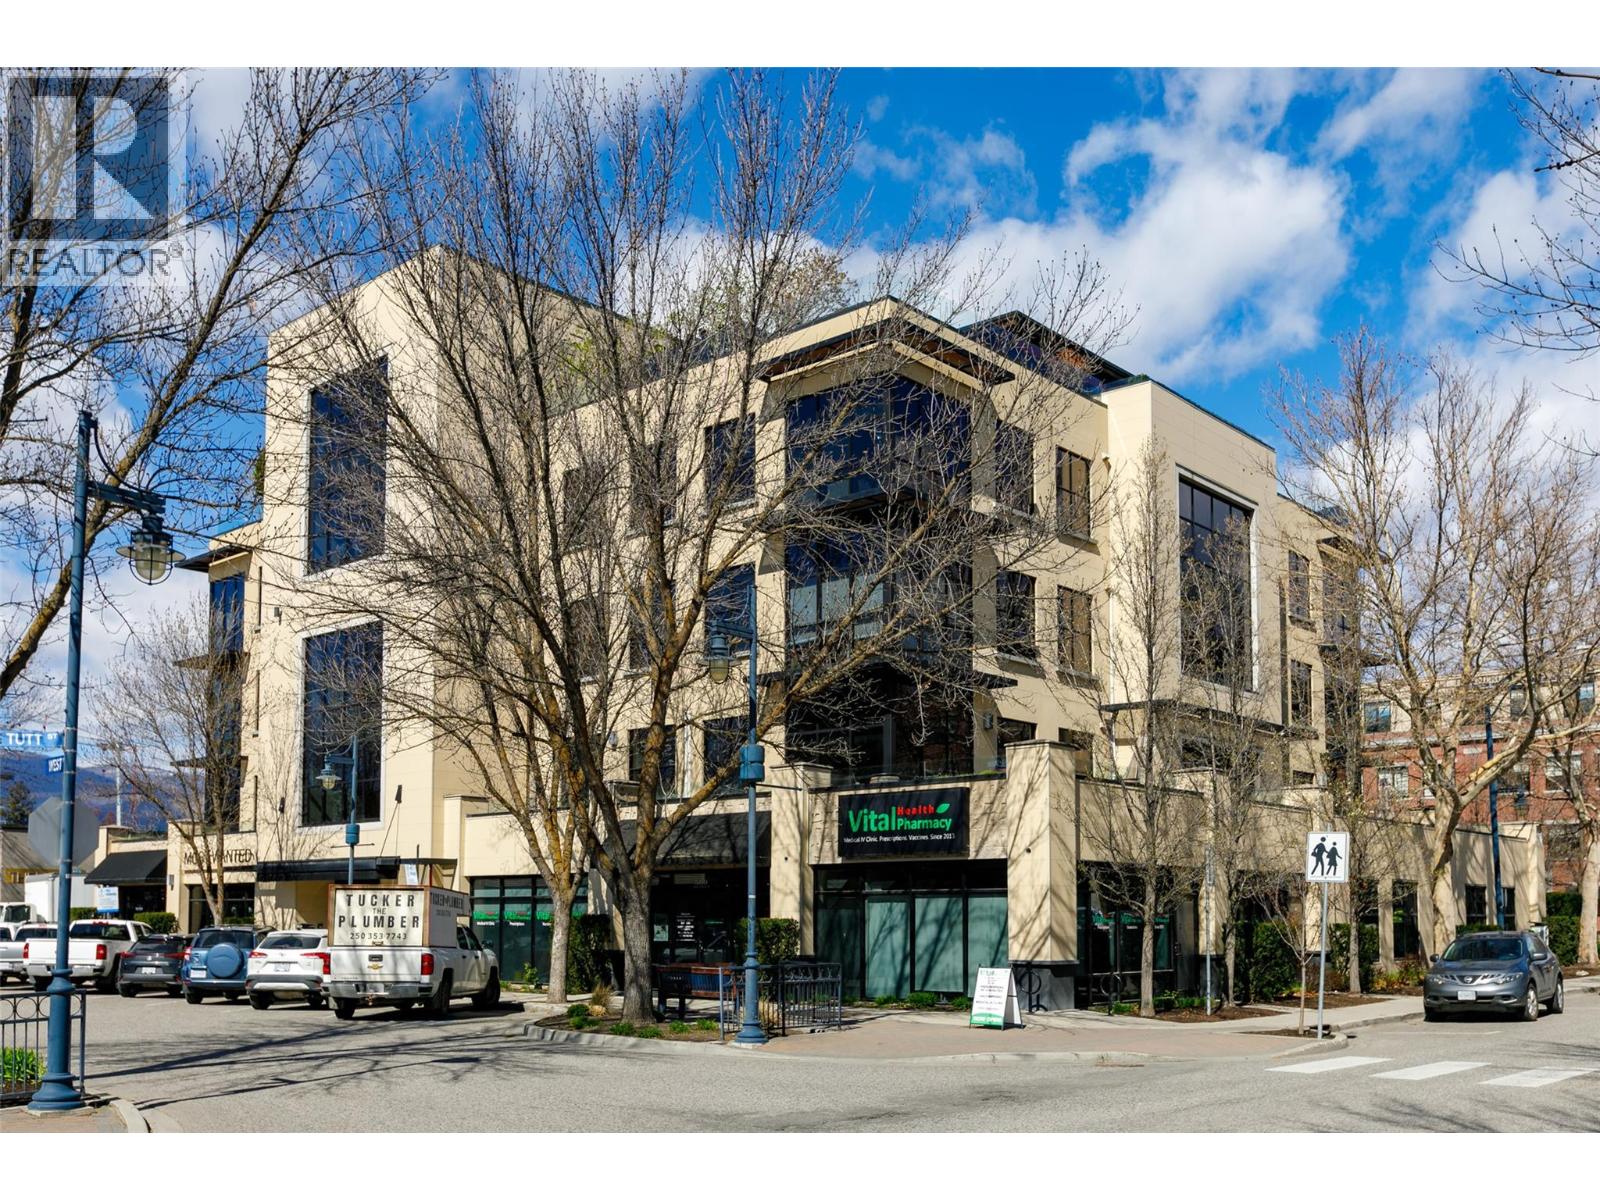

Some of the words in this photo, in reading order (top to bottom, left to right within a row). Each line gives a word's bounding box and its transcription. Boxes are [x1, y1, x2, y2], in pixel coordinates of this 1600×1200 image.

[6, 732, 42, 745] TUTT
[897, 804, 935, 816] Health
[848, 806, 896, 832] Vital
[897, 818, 952, 832] Pharmacy
[184, 850, 211, 865] MOS
[211, 848, 252, 864] WNTED
[346, 894, 414, 907] TUCKER
[338, 915, 420, 929] PLUMBER
[350, 932, 366, 940] 250
[367, 932, 384, 940] 353
[386, 932, 408, 940] 7743
